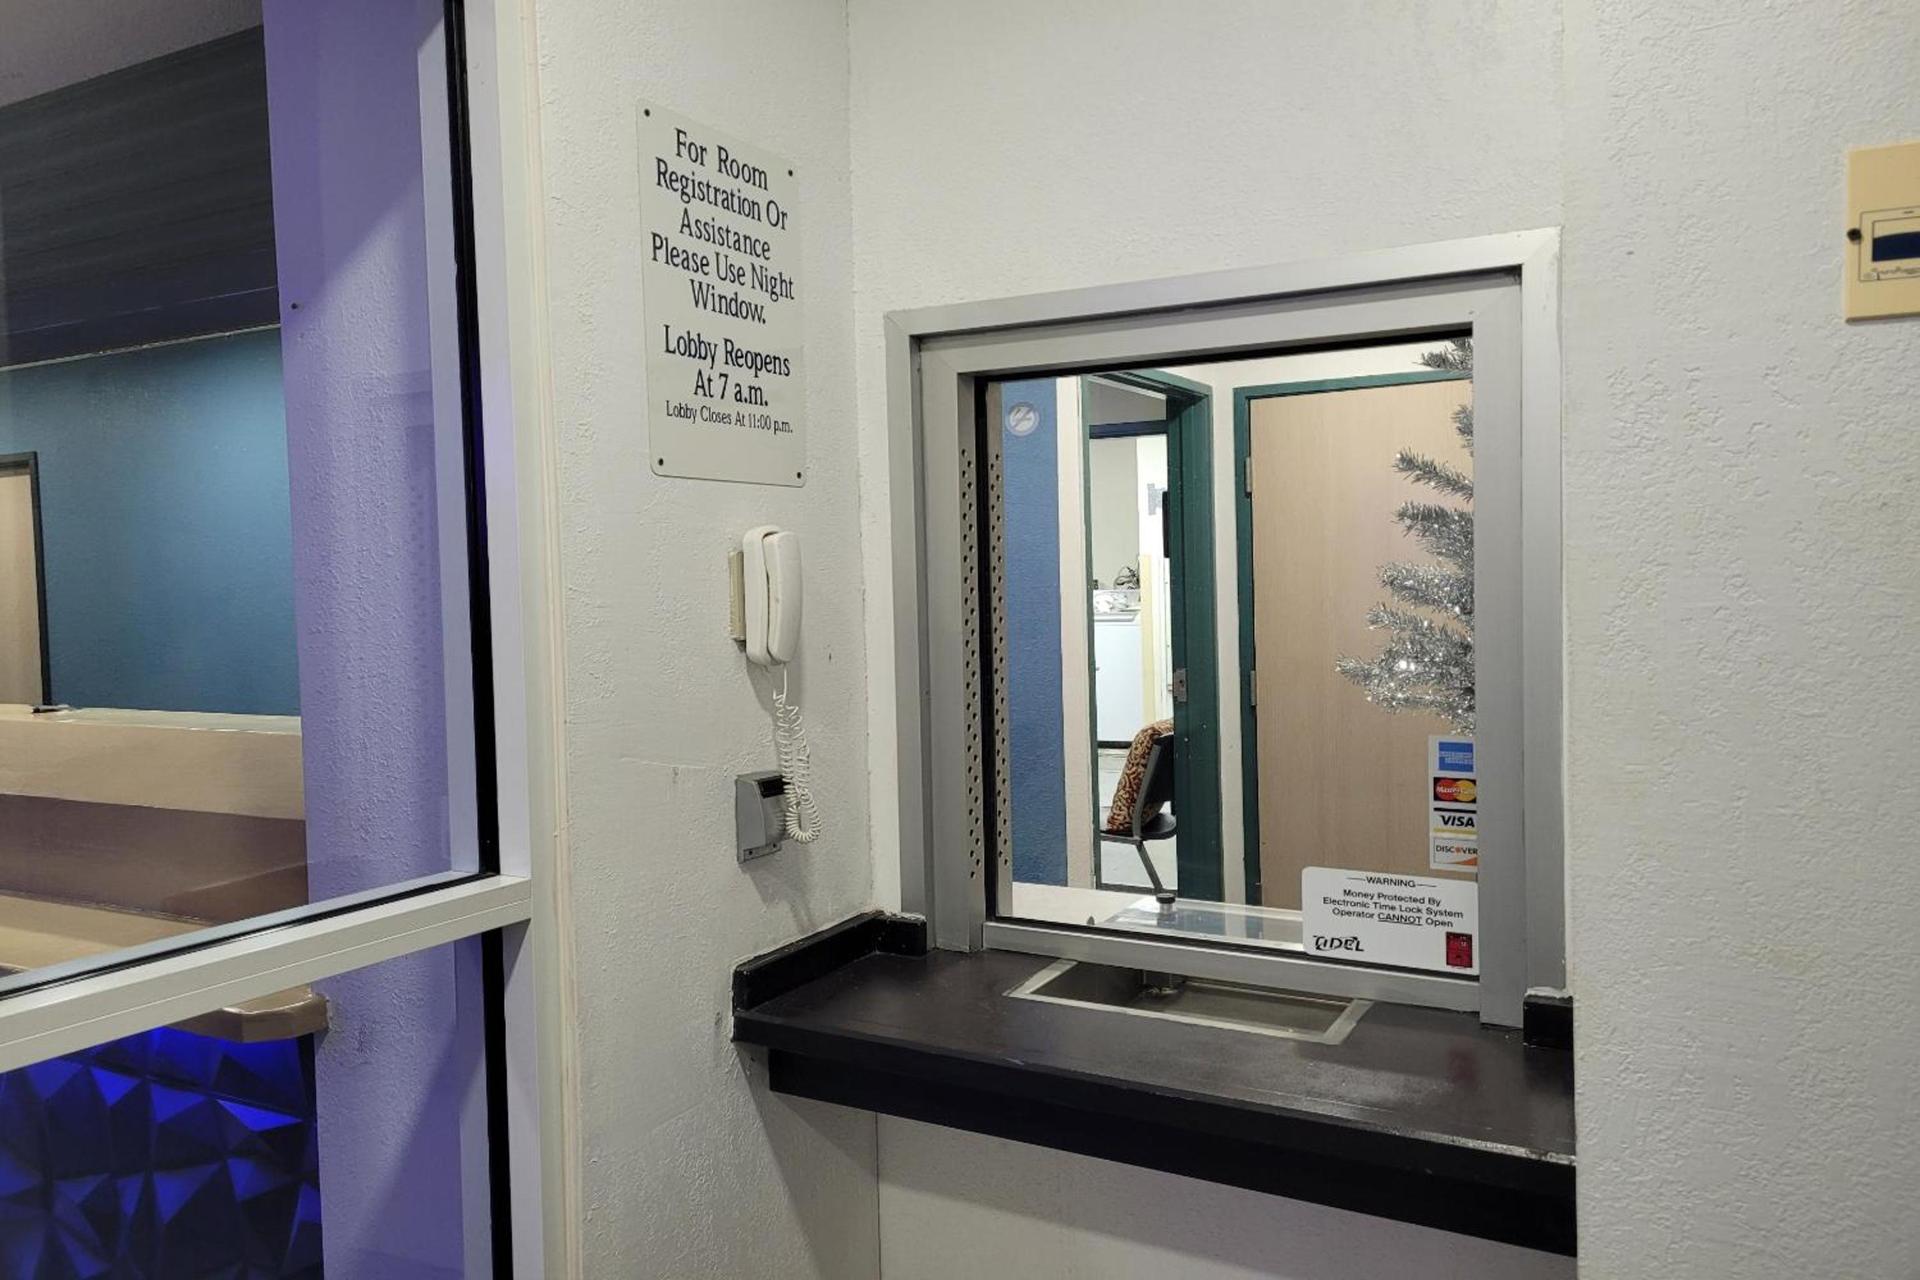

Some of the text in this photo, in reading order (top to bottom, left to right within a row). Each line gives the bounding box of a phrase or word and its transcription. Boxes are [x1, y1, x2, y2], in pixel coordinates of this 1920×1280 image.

[675, 127, 769, 191] For Room
[656, 156, 788, 231] Registration Or
[679, 207, 771, 261] Assistance
[651, 231, 795, 302] Please Use Night
[689, 278, 766, 324] Window.
[664, 324, 791, 378] Lobby Reopens
[693, 368, 769, 407] At 7 a.m.
[666, 400, 793, 435] Lobby Closes At 11:00 p.m.
[1441, 815, 1475, 828] VISA
[1435, 844, 1478, 855] DISCOVER
[1343, 889, 1441, 907] Money Protected By
[1366, 876, 1416, 888] WARNING
[1323, 896, 1464, 919] Electronic Time Lock System
[1332, 907, 1453, 928] Operator CANNOT Open
